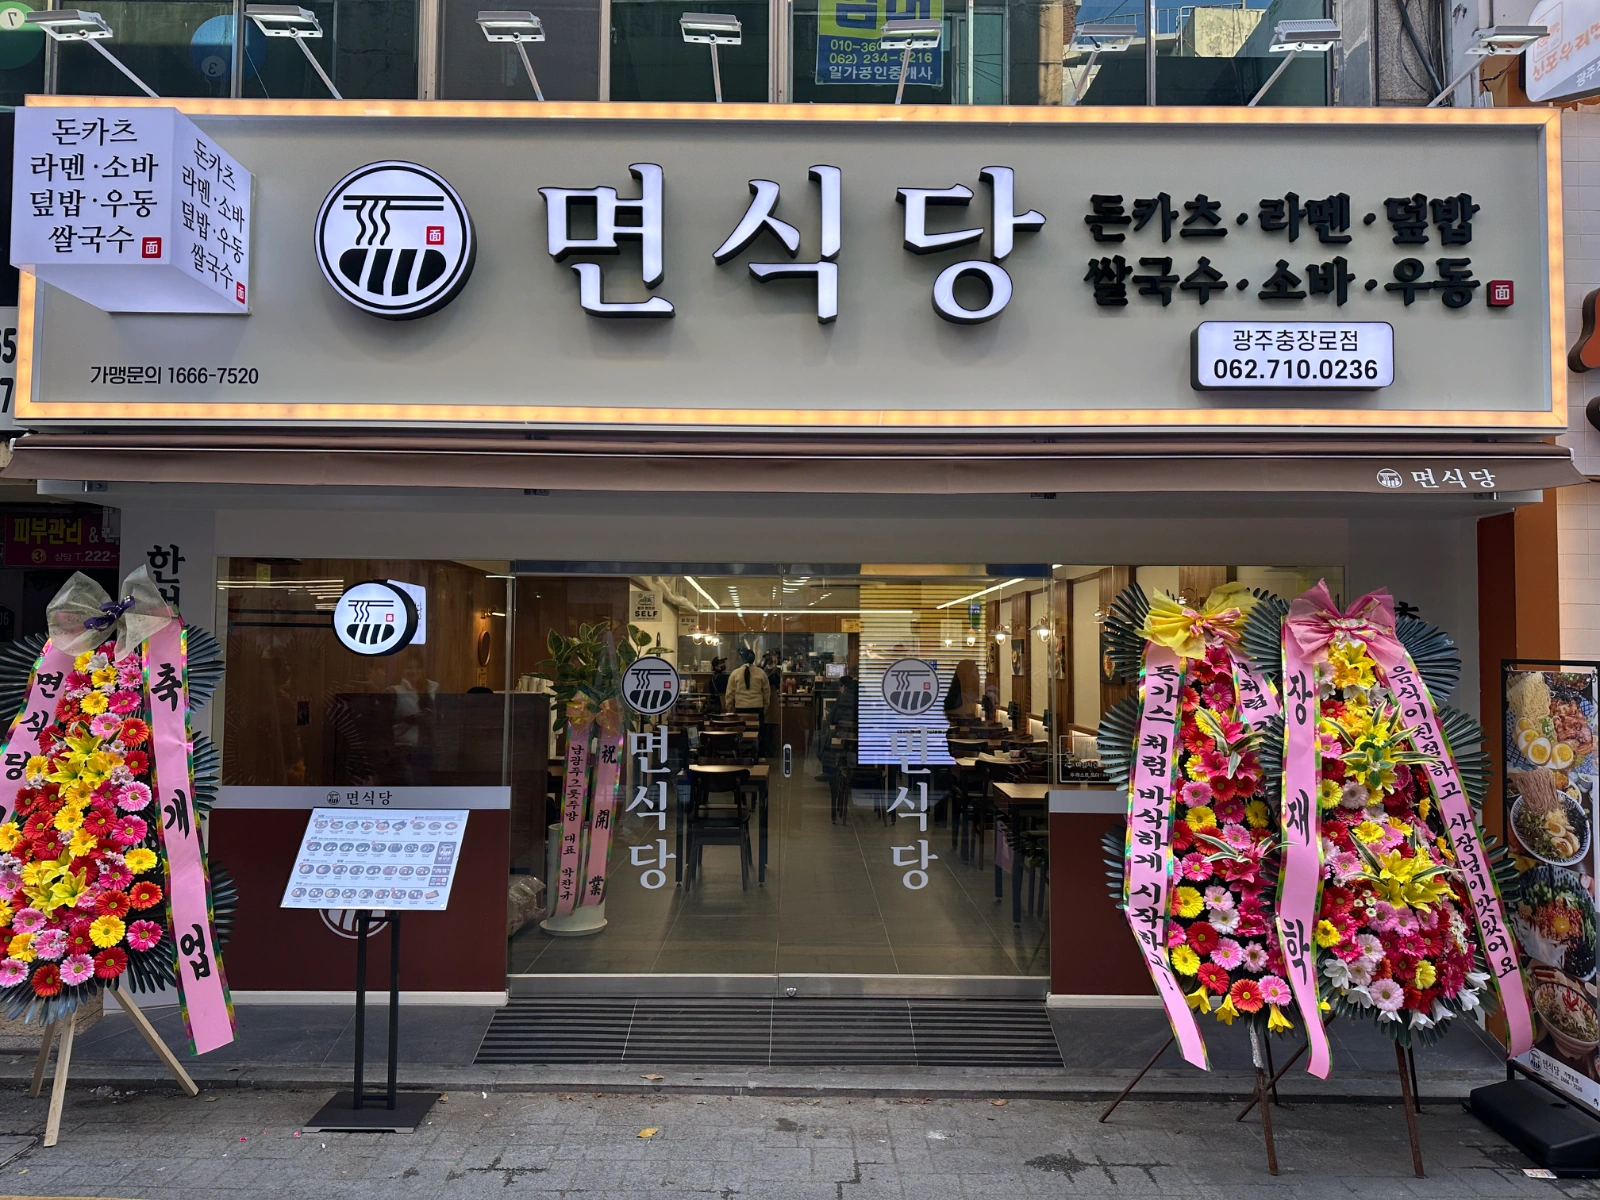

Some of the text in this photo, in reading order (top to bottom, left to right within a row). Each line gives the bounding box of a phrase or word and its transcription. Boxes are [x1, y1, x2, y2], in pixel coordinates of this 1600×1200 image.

[828, 65, 933, 80] 일가공인중개사
[829, 52, 933, 65] 062) 234-8216
[1576, 62, 1600, 87] 광주
[52, 118, 138, 146] 돈카츠
[195, 137, 236, 191] 돈카츠
[48, 225, 135, 254] 쌀국수
[538, 162, 1047, 324] 면식당
[190, 242, 234, 290] 쌀국수
[1232, 330, 1359, 353] 광주충장로점
[90, 365, 259, 385] 가맹문의 1666-7520
[1213, 358, 1379, 381] 062.710.0236
[1411, 467, 1496, 489] 면식당
[13, 517, 82, 545] 피부관리
[88, 526, 99, 543] &
[1145, 664, 1181, 724] 돈가스
[5, 671, 63, 782] 면식당
[1140, 733, 1168, 777] 처럼
[346, 790, 392, 806] 면식당
[625, 724, 677, 890] 면식당
[886, 725, 939, 890] 면식당
[1134, 785, 1173, 872] 바삭하게
[563, 833, 577, 856] 대표
[1542, 1059, 1560, 1077] 면식당
